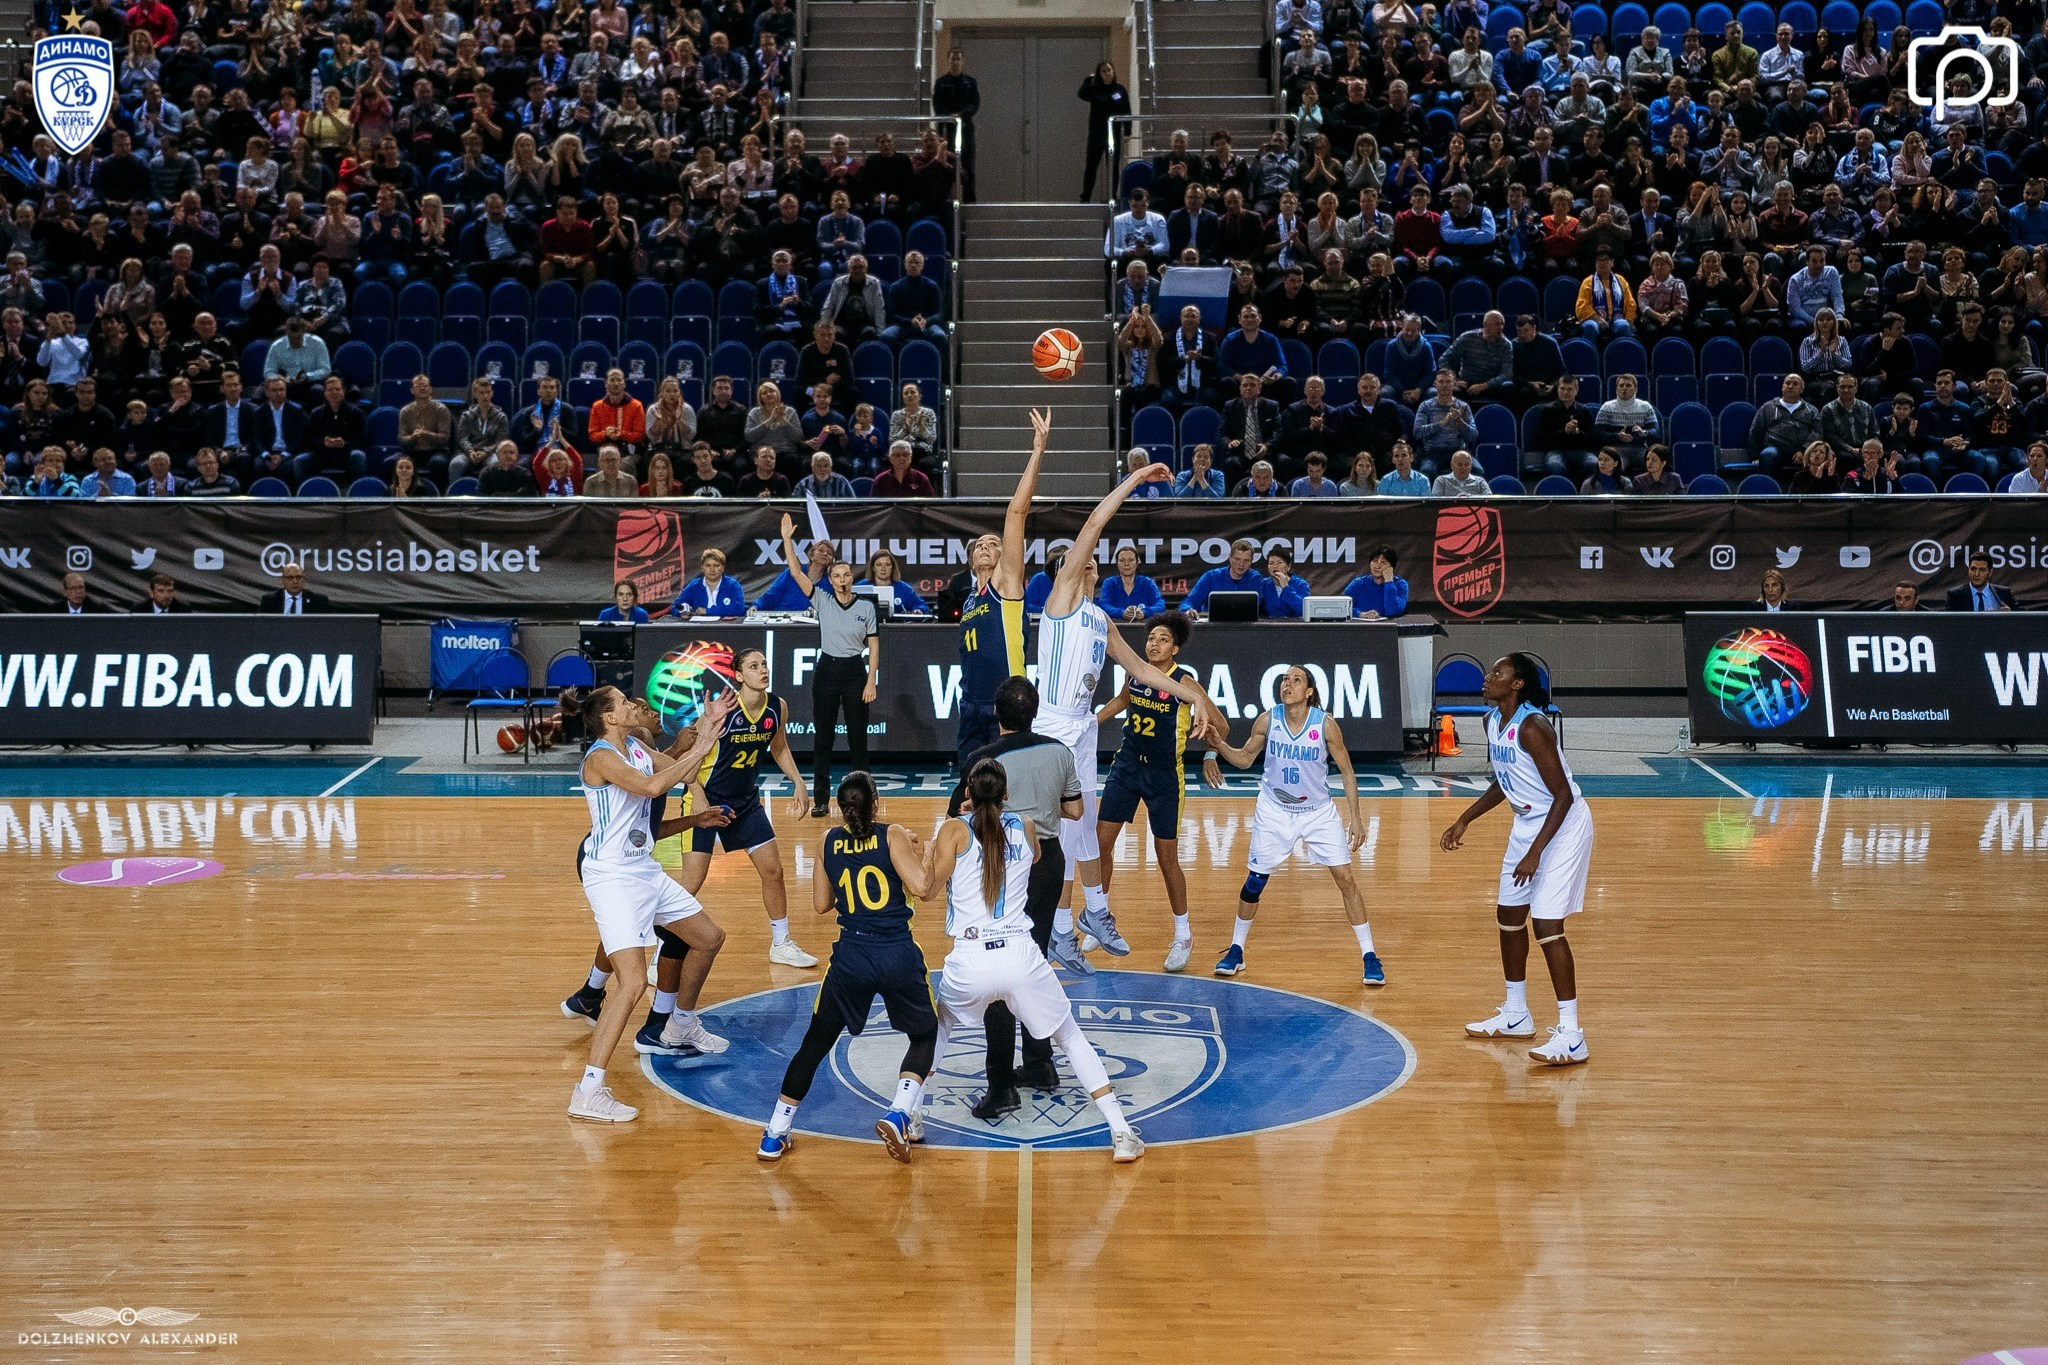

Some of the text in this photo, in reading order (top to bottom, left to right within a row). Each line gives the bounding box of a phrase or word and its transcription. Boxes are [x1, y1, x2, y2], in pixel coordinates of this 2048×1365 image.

[260, 540, 541, 577] @russiabasket
[1453, 578, 1492, 605] ЛИГА
[442, 635, 500, 650] molten
[964, 627, 978, 652] 11
[1847, 635, 1937, 673] FIBA
[1131, 713, 1156, 738] 32
[1846, 708, 1950, 721] We Are Basketball
[731, 749, 759, 769] 24
[1269, 739, 1320, 762] DYNAMO
[833, 835, 878, 855] PLUM
[838, 864, 890, 914] 10
